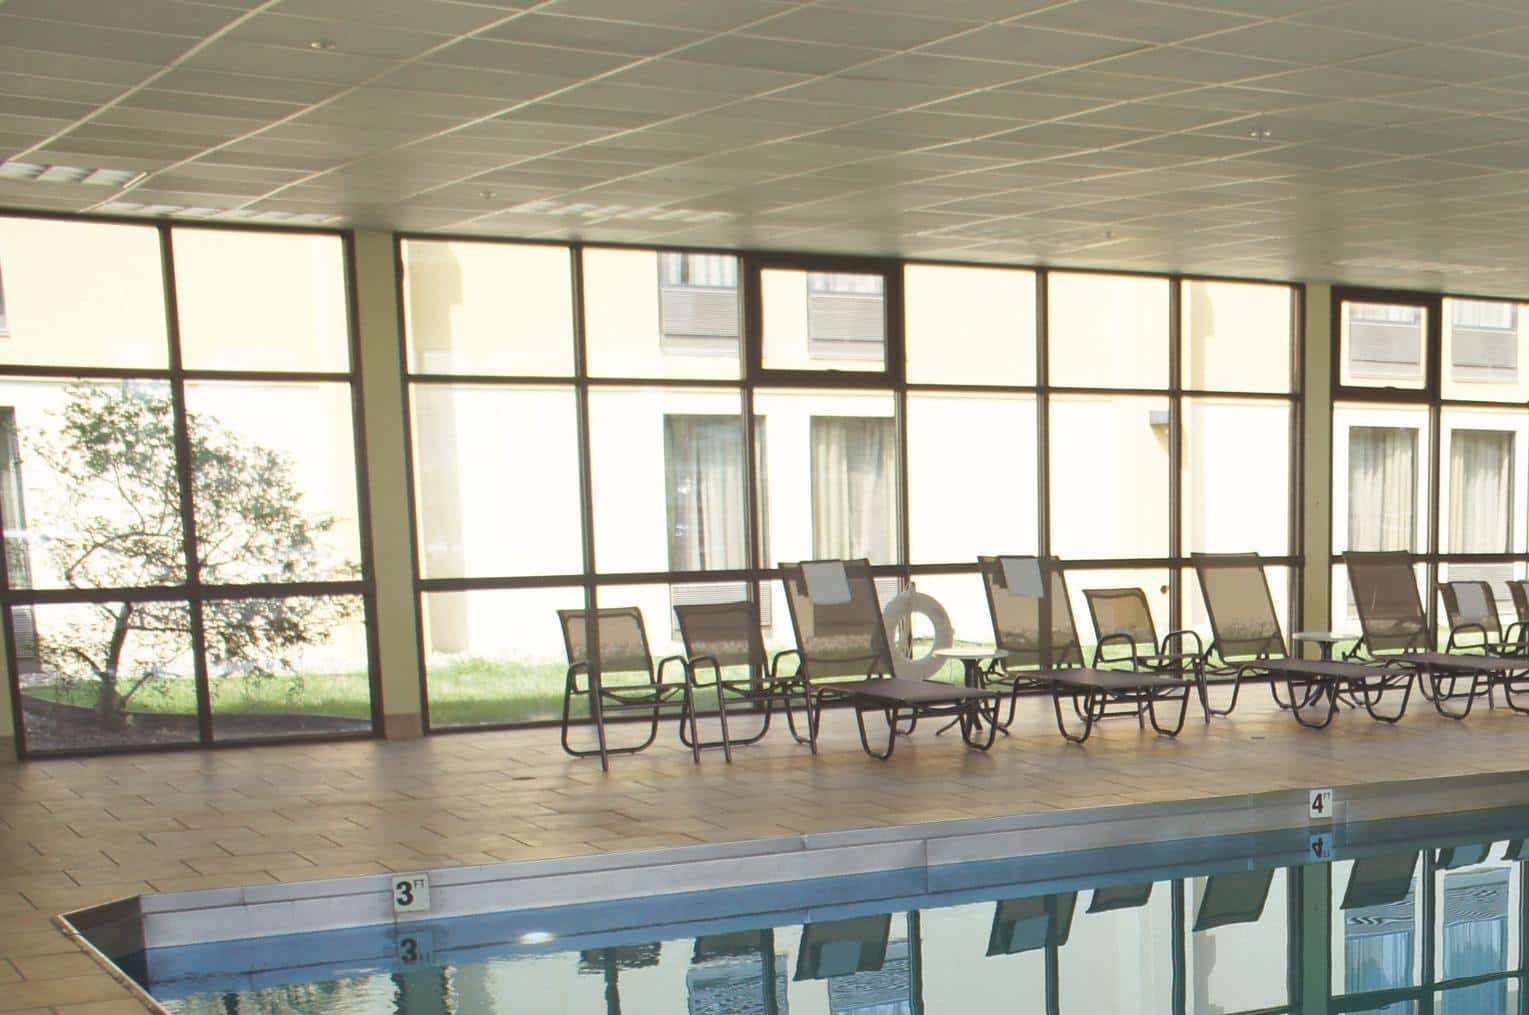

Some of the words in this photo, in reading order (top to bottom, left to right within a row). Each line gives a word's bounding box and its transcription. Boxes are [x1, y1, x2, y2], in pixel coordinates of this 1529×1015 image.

[1312, 793, 1324, 814] 4
[396, 880, 414, 906] 3
[414, 879, 425, 888] FT
